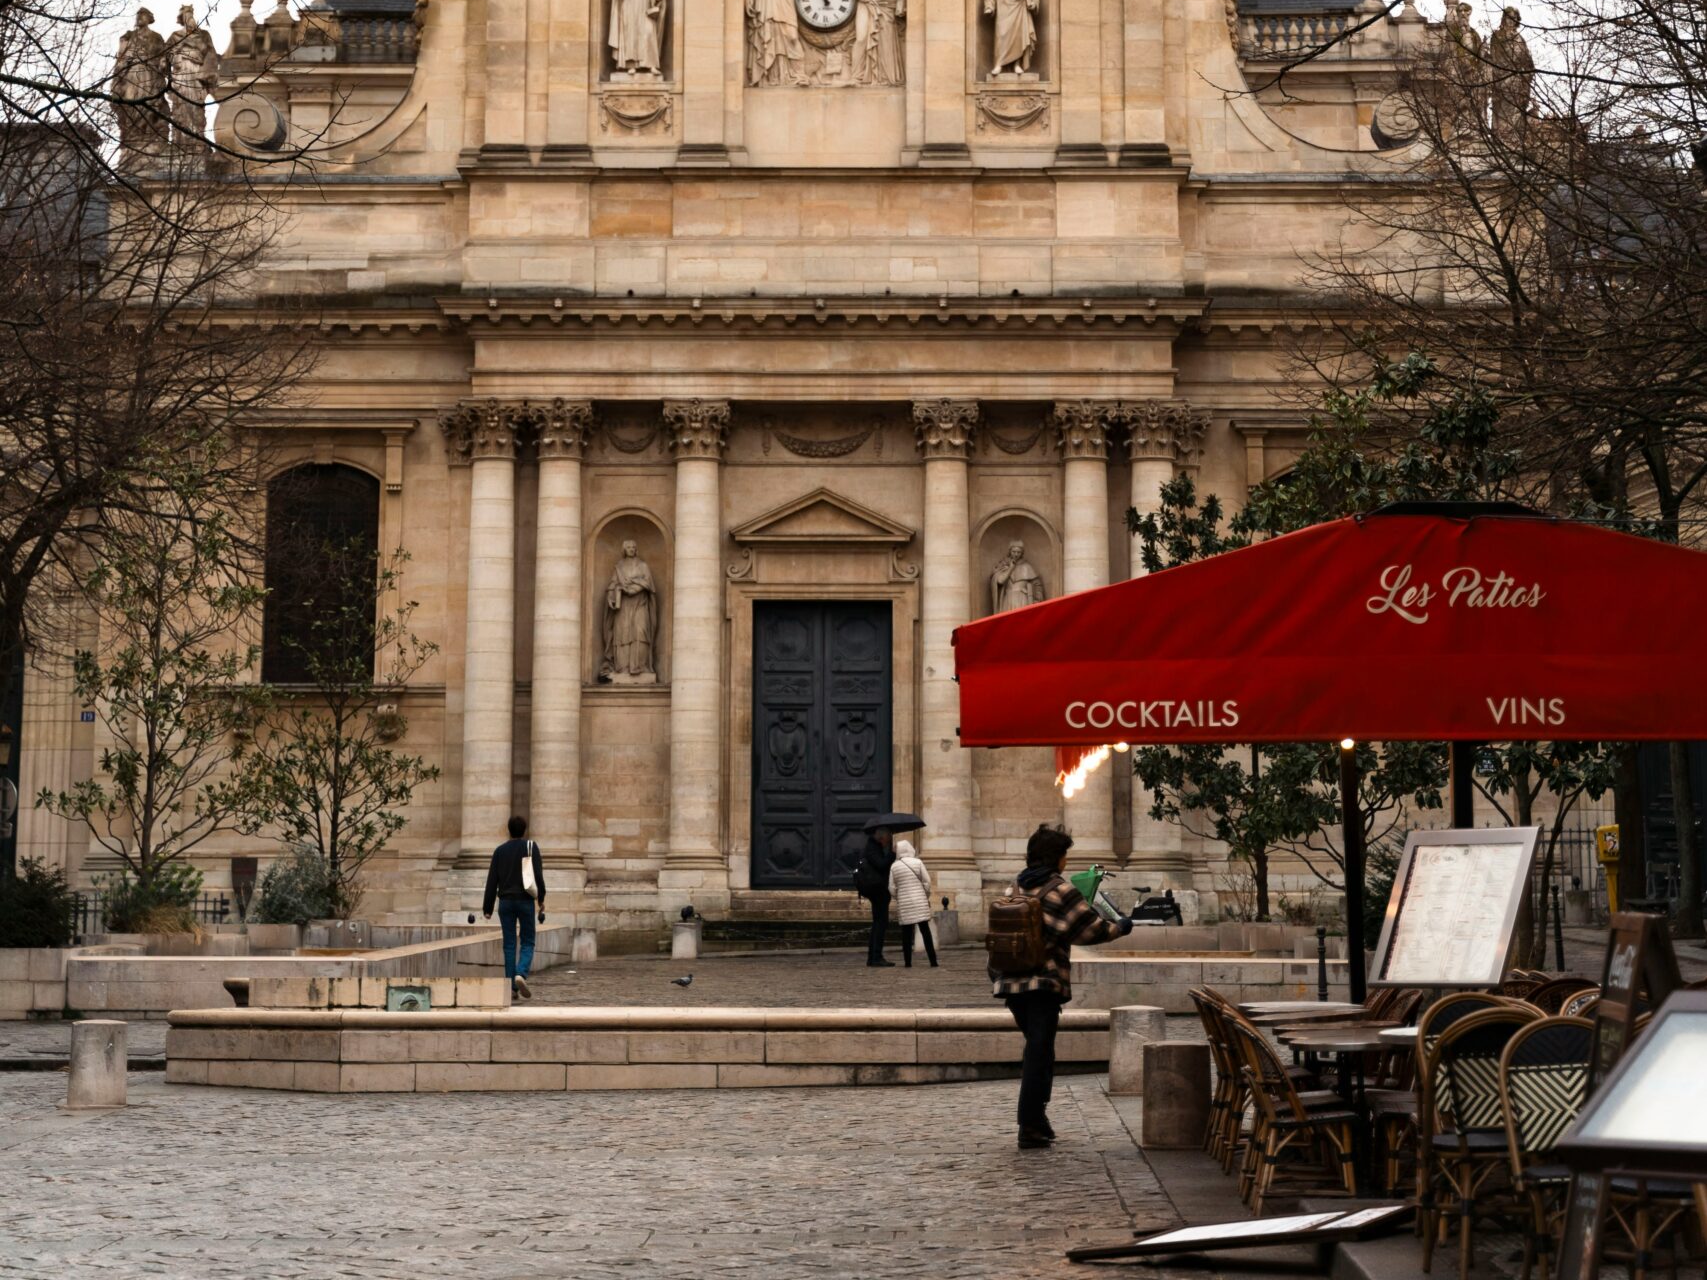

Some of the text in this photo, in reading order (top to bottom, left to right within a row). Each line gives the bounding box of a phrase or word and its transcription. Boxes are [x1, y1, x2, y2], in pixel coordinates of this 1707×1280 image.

[1366, 564, 1547, 624] Les Patios
[1065, 699, 1239, 728] COCKTAILS
[1485, 697, 1566, 725] VINS
